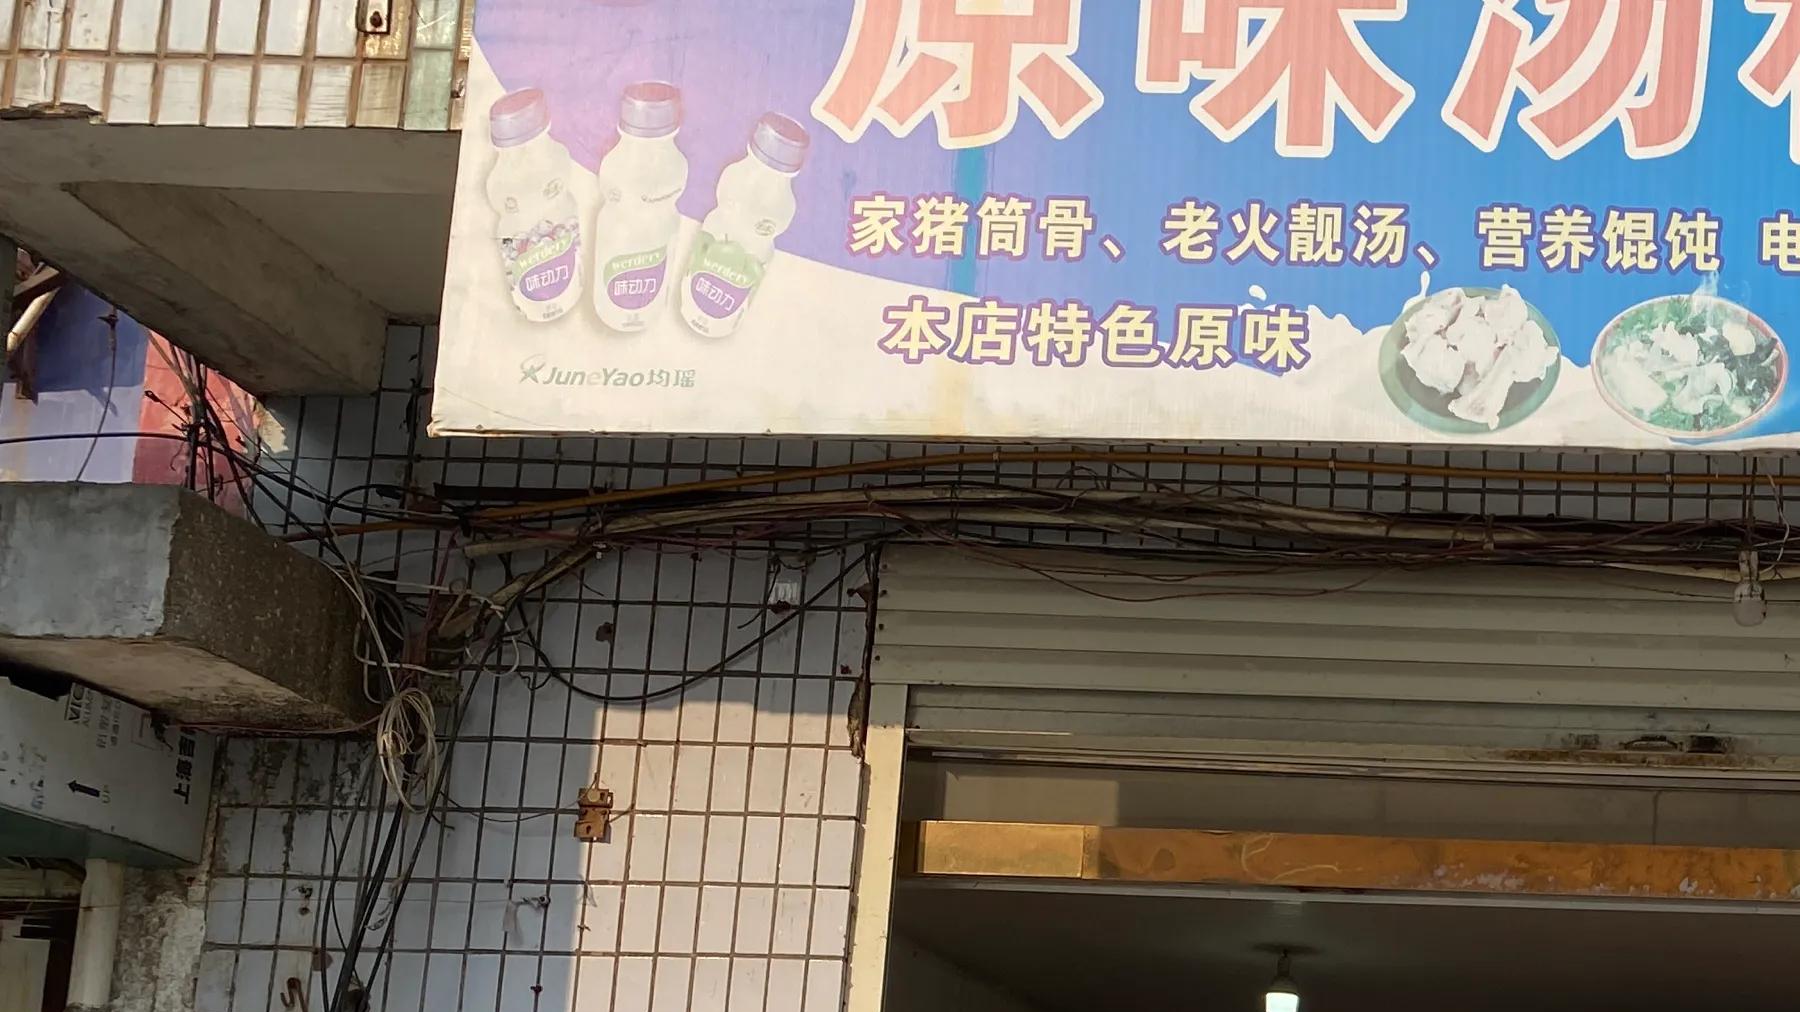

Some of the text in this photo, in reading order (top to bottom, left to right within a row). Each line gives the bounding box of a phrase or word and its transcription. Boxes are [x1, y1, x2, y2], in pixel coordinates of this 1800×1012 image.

[524, 264, 569, 292] 味动力
[613, 277, 657, 297] 味动力
[695, 276, 736, 312] 味动力
[882, 298, 1310, 373] 本店特色原味
